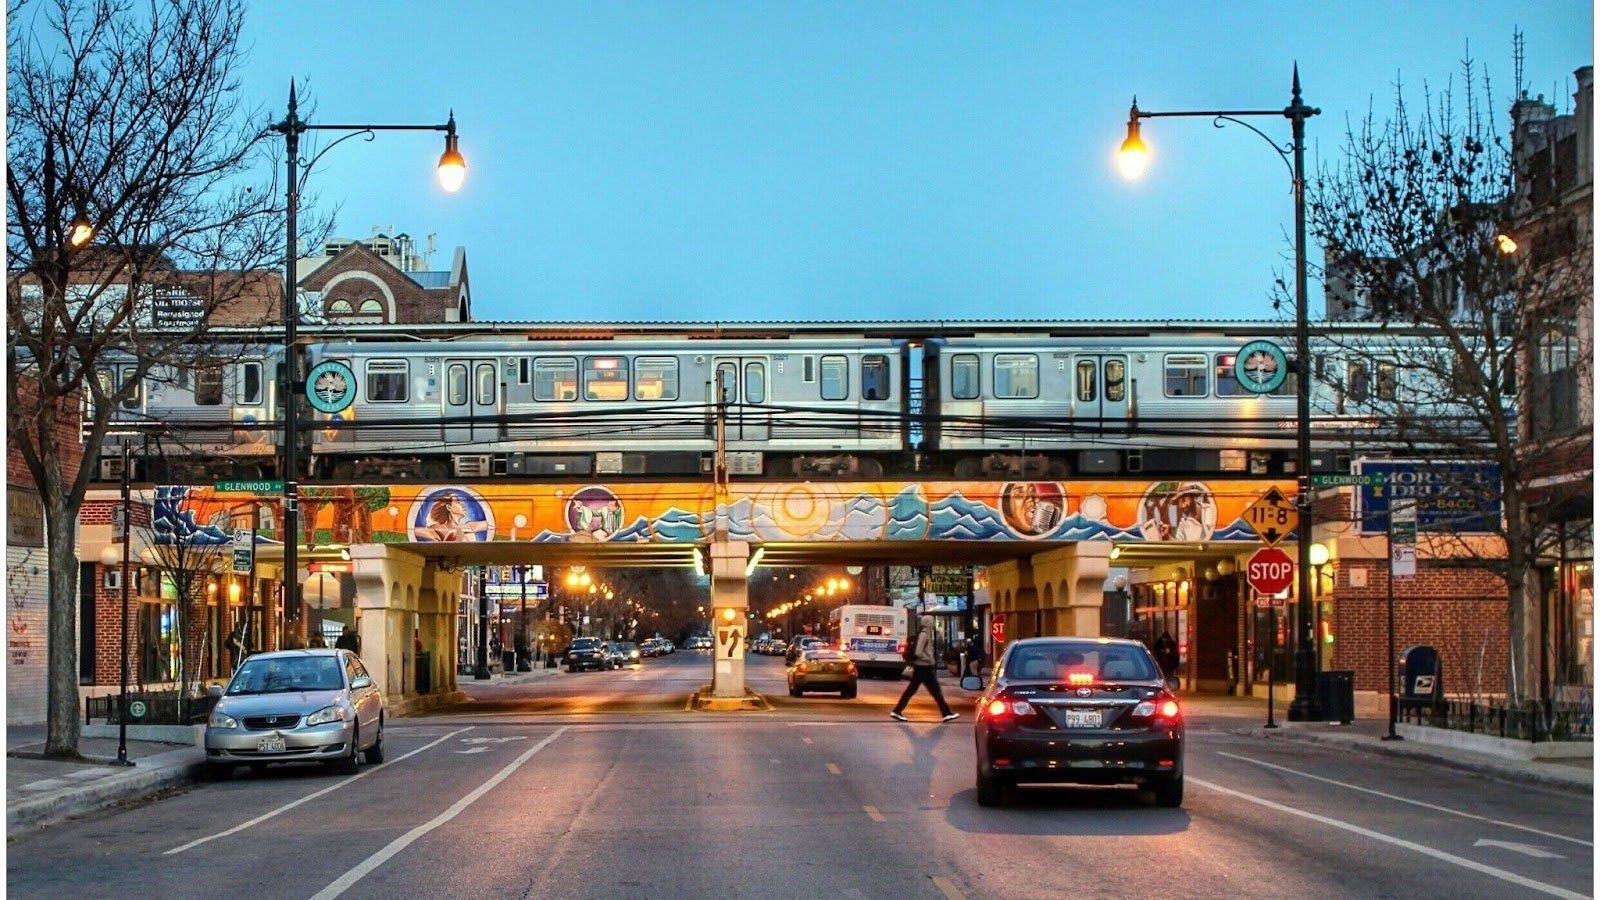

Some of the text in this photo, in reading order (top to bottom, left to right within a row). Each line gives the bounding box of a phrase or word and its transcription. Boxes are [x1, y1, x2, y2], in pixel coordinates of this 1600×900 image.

[1322, 475, 1371, 485] GLENWOOD
[224, 482, 271, 491] GLENWOOD
[1250, 562, 1292, 580] STOP
[992, 622, 1005, 634] ST
